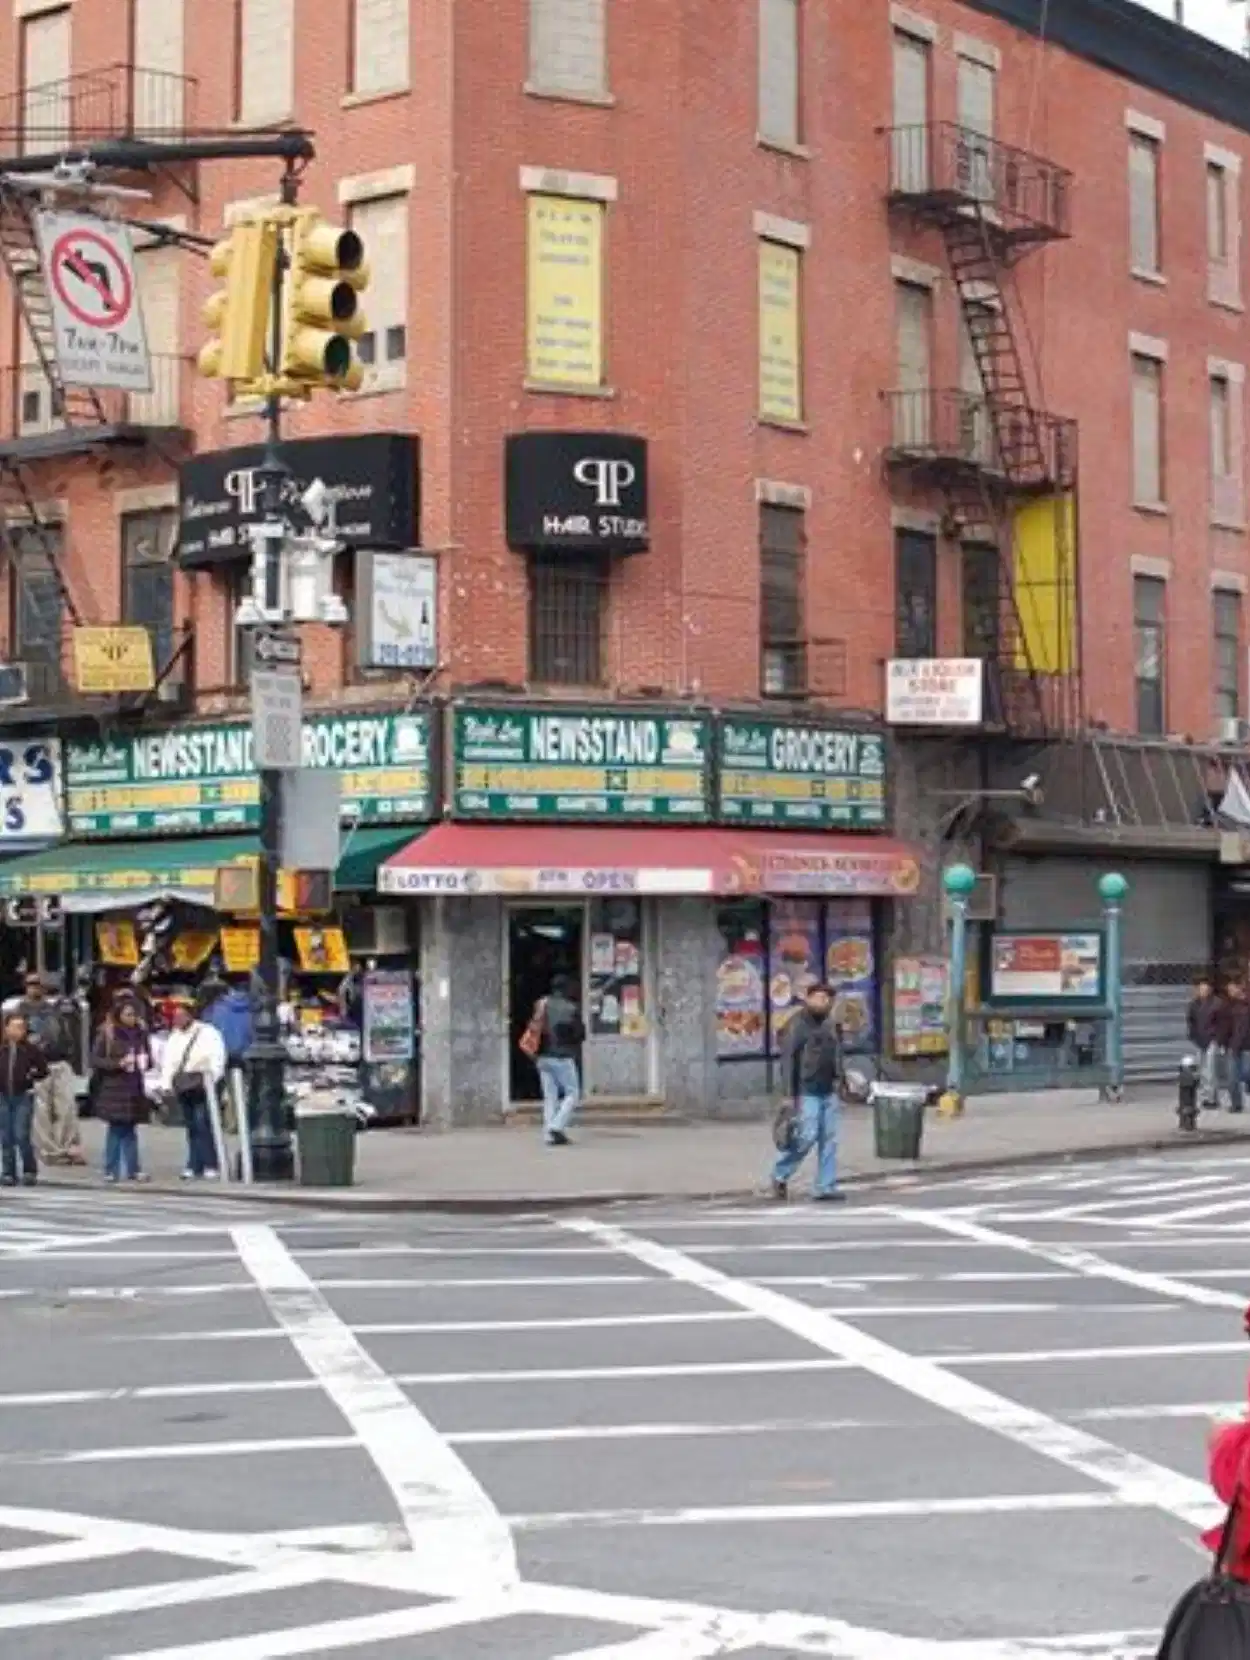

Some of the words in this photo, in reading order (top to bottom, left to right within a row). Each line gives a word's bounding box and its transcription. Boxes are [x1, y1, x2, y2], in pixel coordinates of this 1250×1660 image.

[543, 515, 592, 535] HAIR
[131, 726, 255, 781] NEWSSTAND
[301, 718, 389, 768] ROCERY
[529, 715, 659, 764] NEWSSTAND
[771, 727, 858, 772] GROCERY
[397, 871, 458, 889] LOTTO
